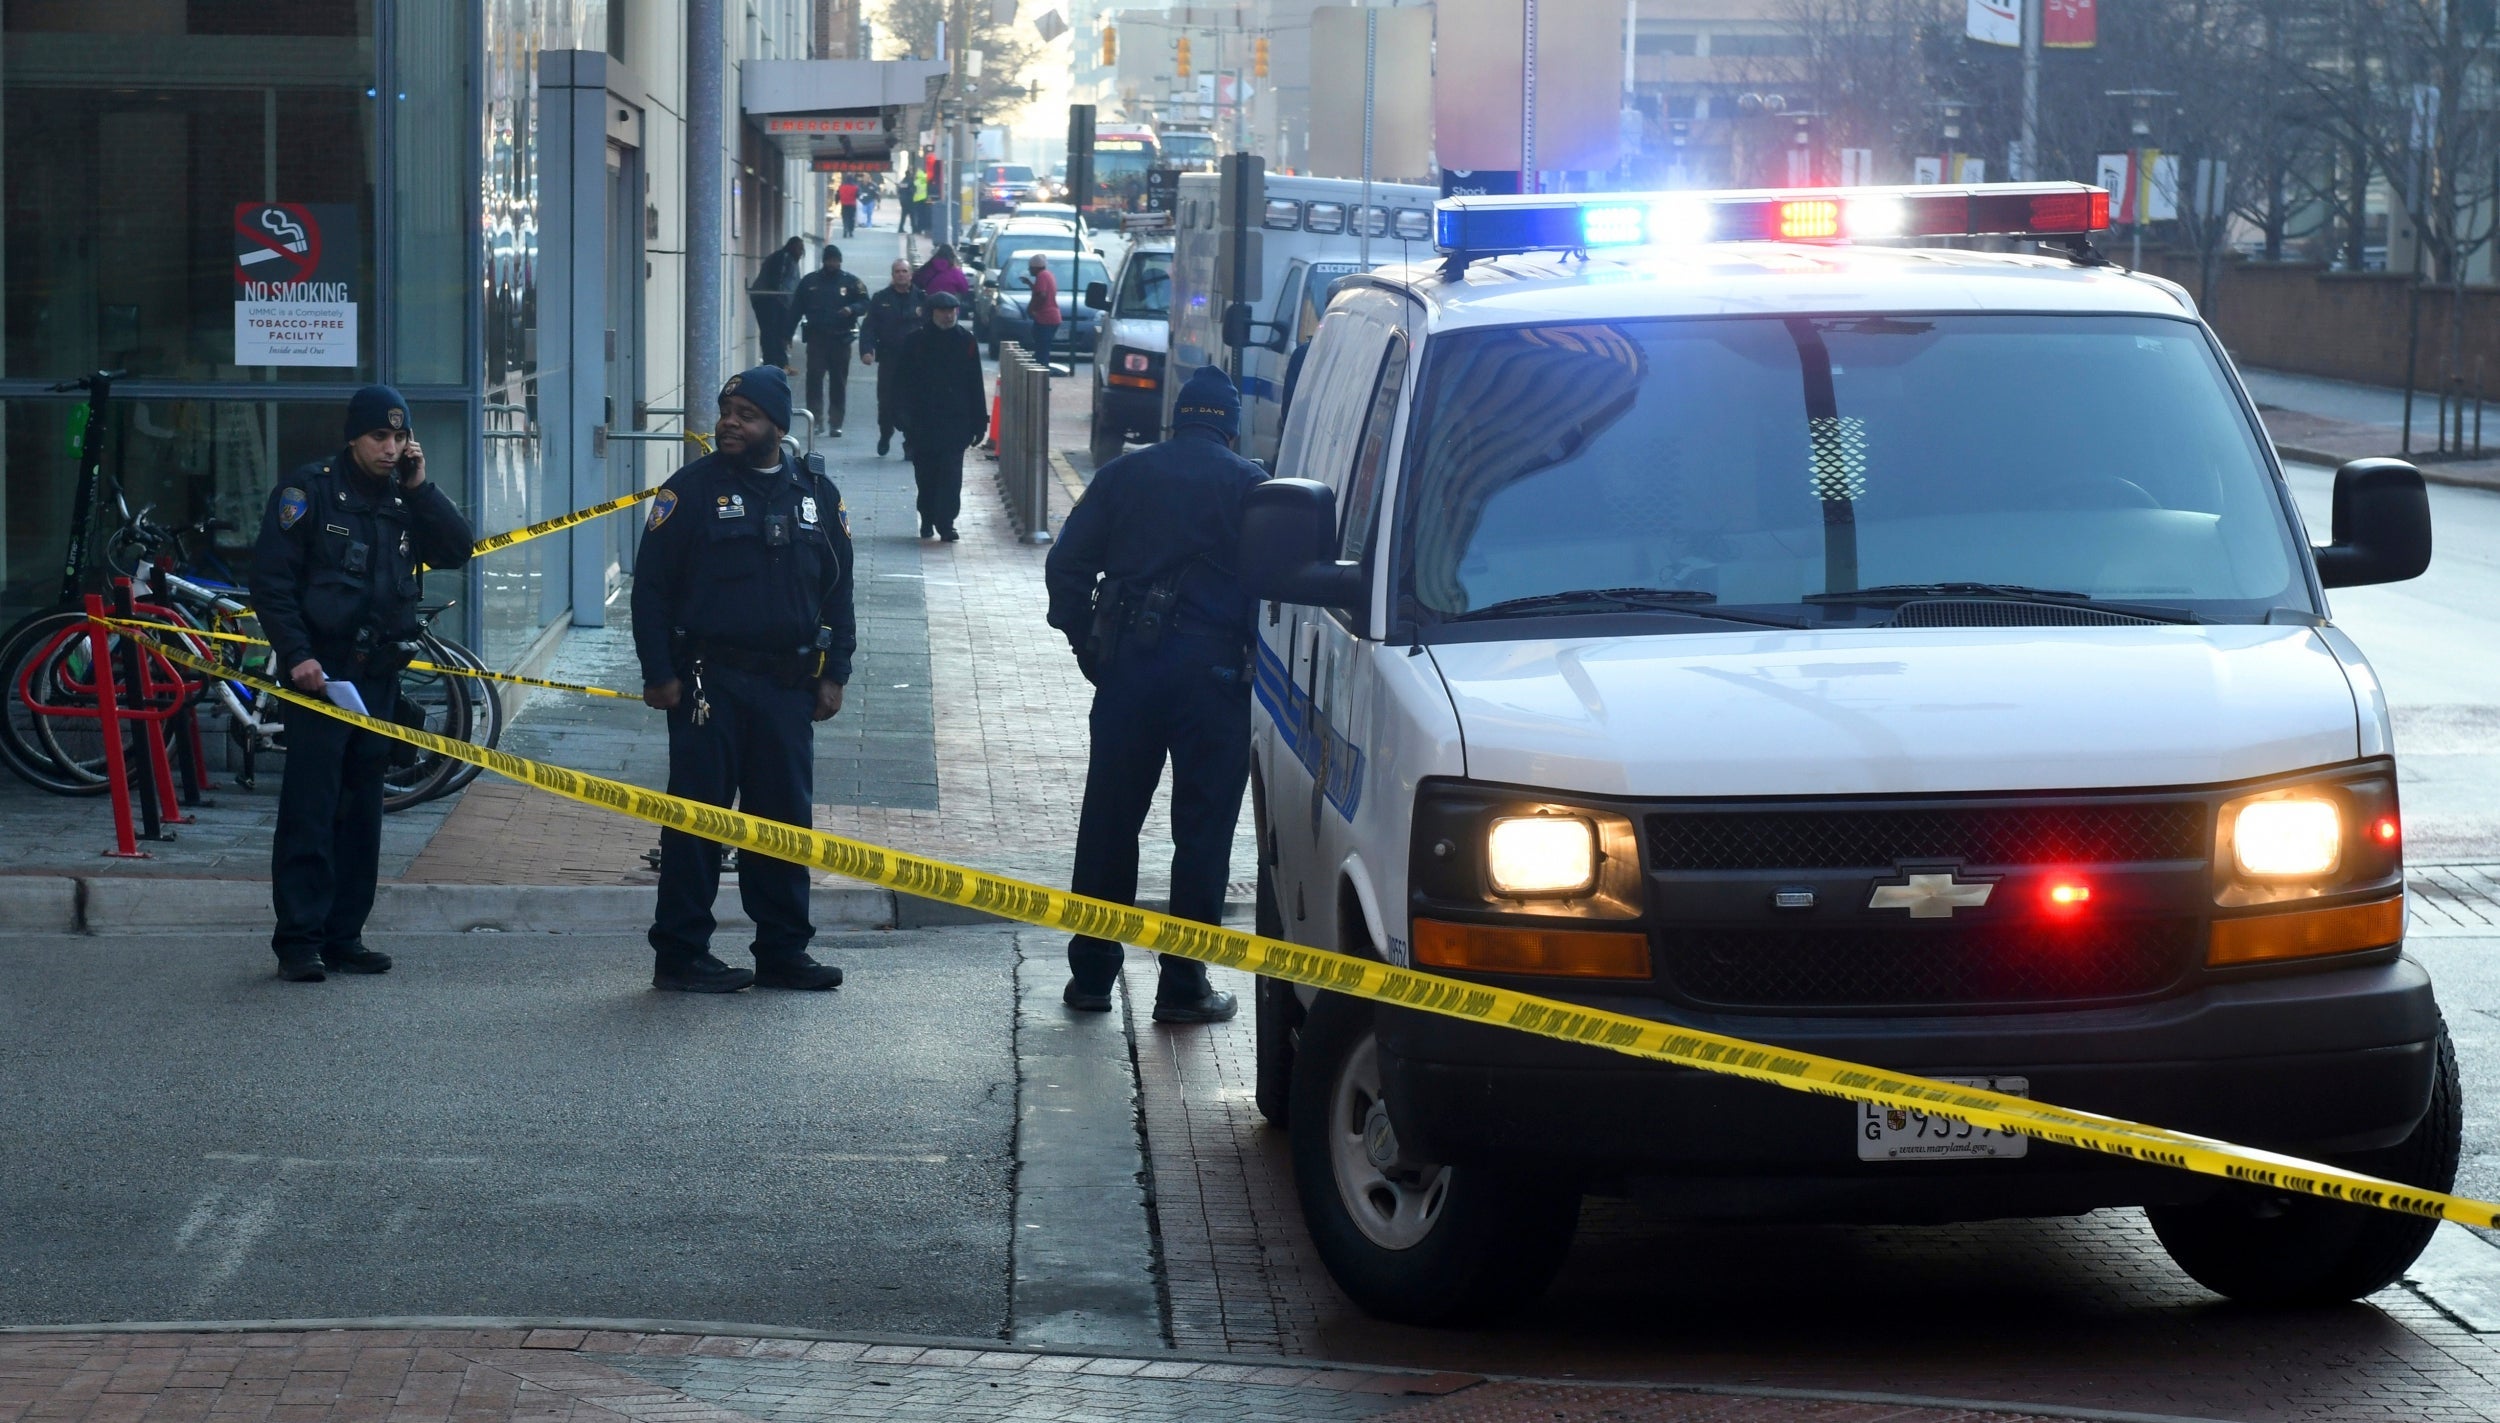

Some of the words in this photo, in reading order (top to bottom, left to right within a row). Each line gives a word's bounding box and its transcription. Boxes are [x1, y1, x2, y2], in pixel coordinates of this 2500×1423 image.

[771, 120, 876, 131] EMERGENCY
[1452, 185, 1487, 195] Shock
[245, 281, 267, 301] NO
[271, 281, 348, 302] SMOKING
[249, 308, 276, 316] UMMC
[279, 308, 285, 316] is
[295, 308, 343, 318] Completely
[249, 319, 344, 328] TOBACCO-FREE
[269, 331, 323, 340] FACILITY
[268, 346, 291, 354] Inside
[1865, 1121, 1881, 1140] G
[1899, 1142, 1987, 1156] www.maryland.gov
